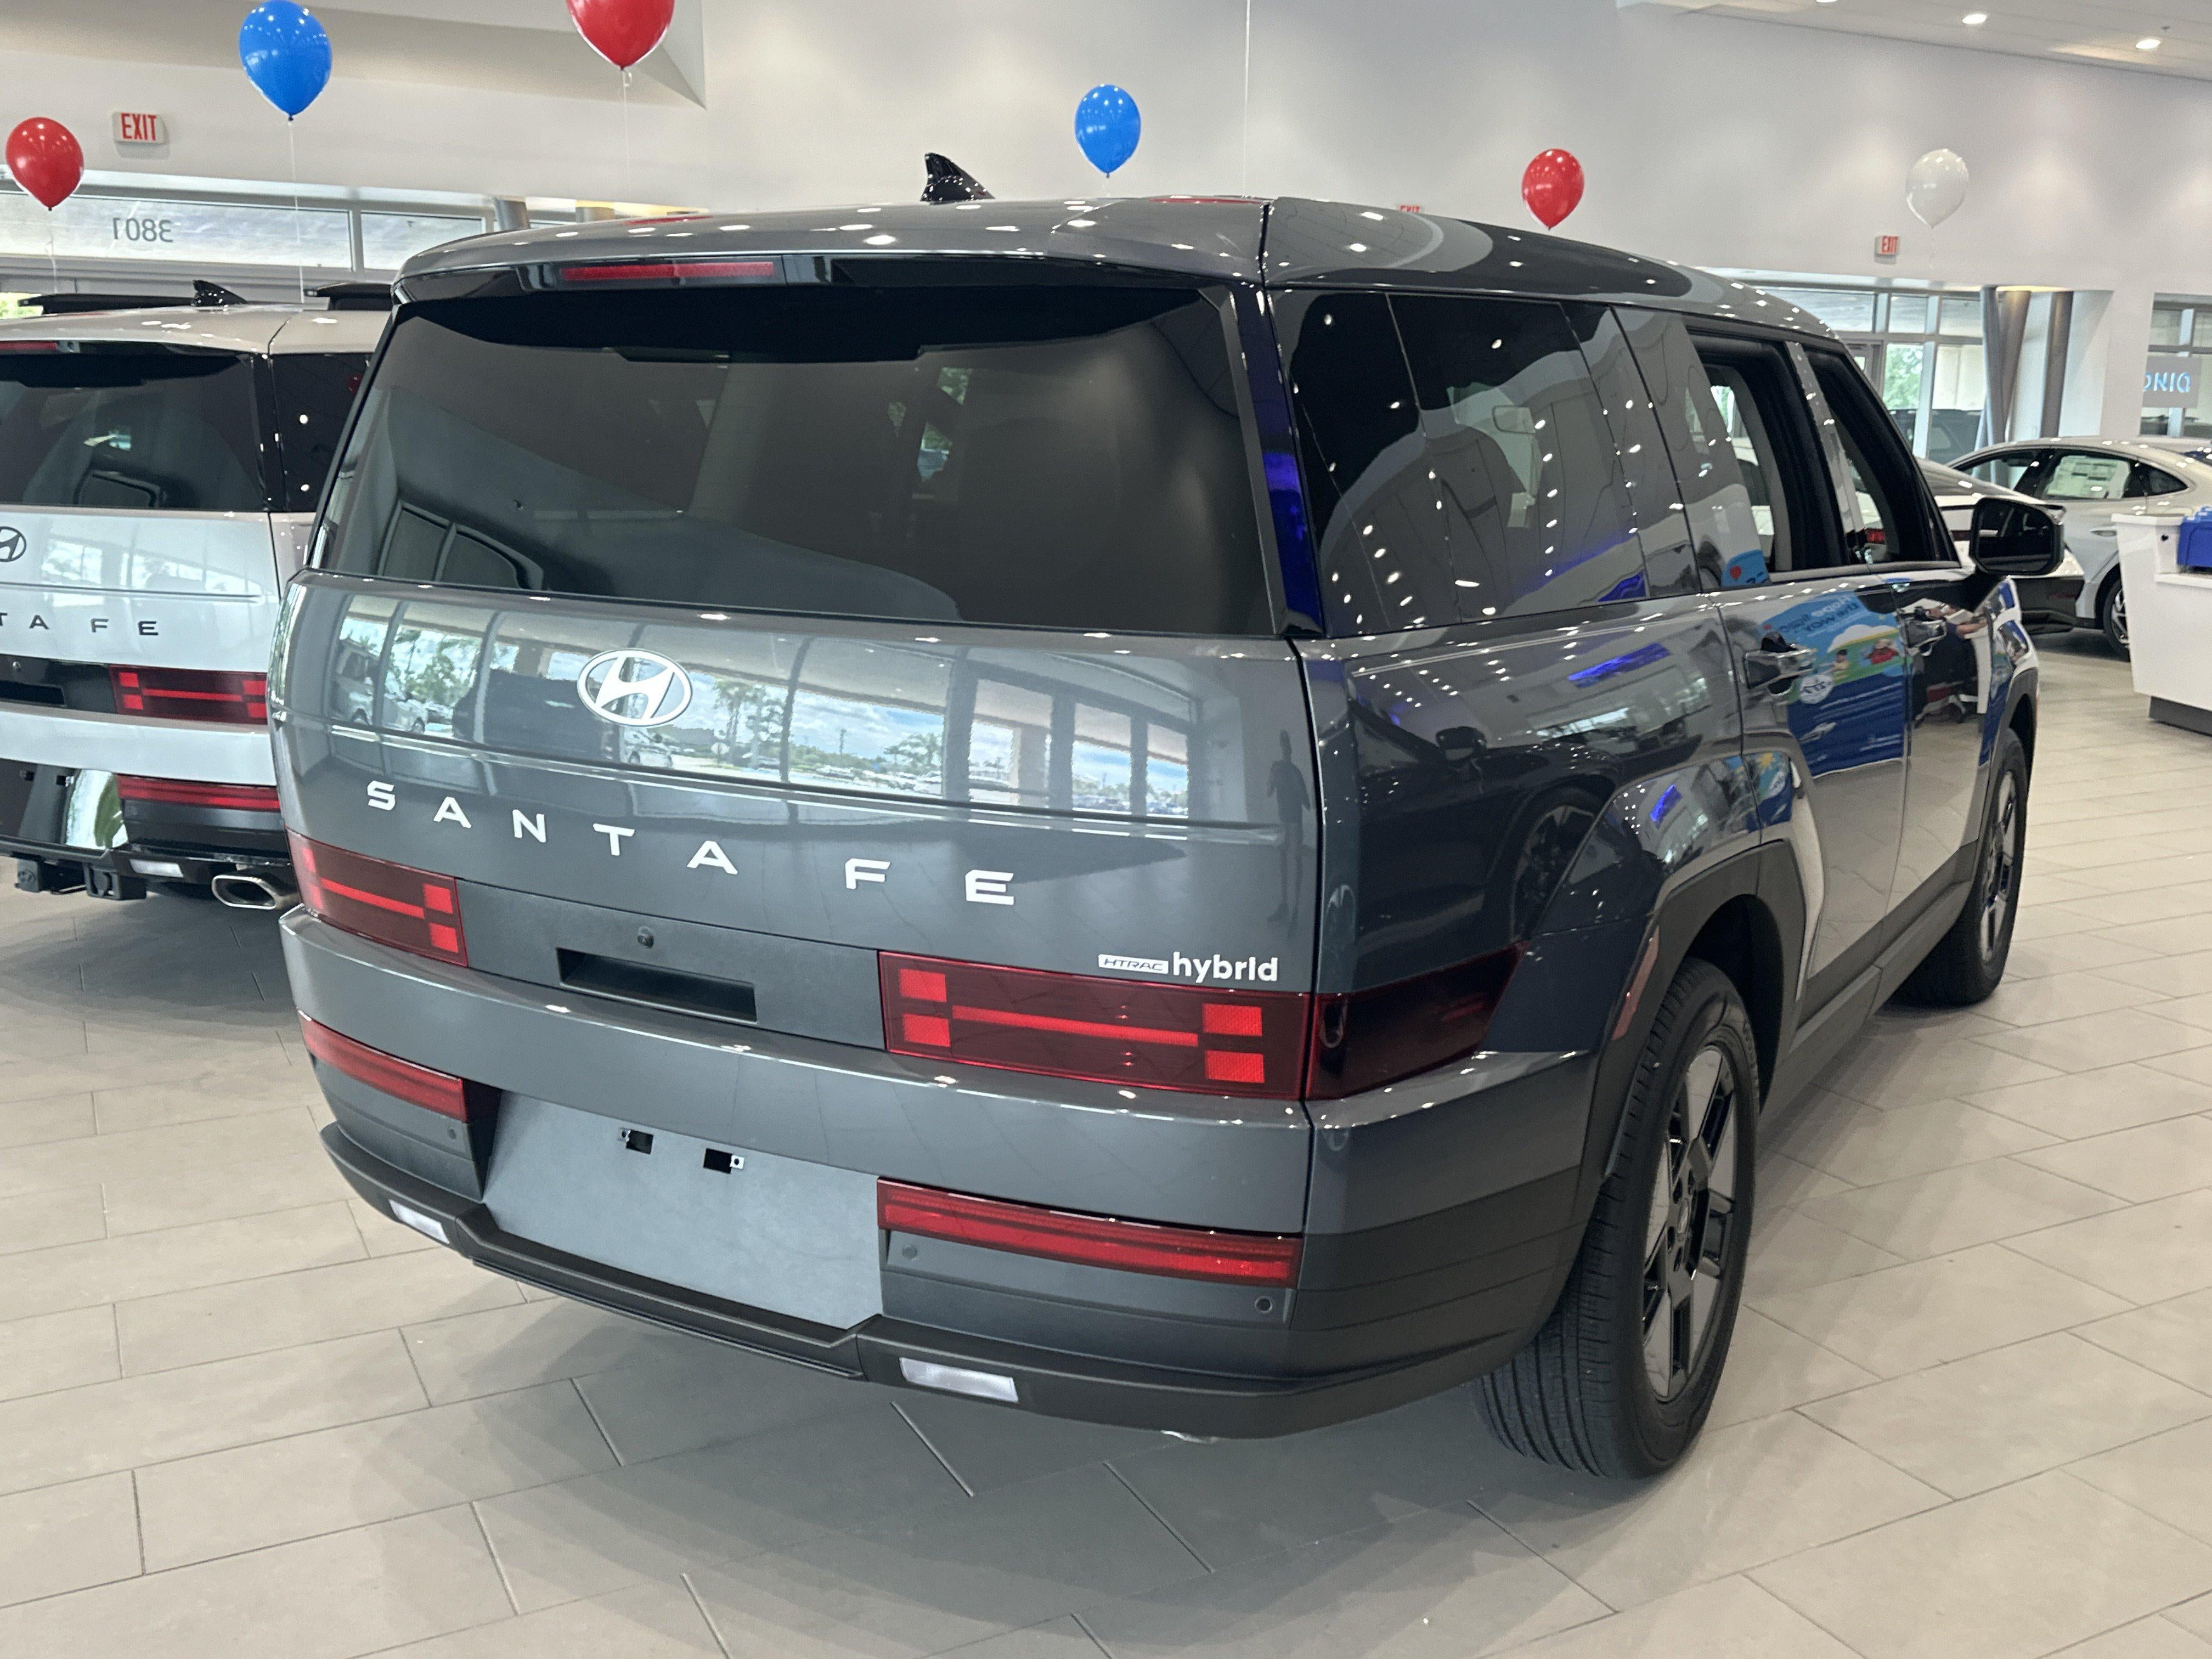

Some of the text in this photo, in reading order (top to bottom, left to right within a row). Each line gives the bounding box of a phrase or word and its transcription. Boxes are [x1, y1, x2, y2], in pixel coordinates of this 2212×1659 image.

[121, 112, 157, 140] EXIT
[91, 618, 159, 635] FE
[367, 780, 1014, 905] SANTA FE
[1104, 951, 1278, 983] HTRAC hybrid
